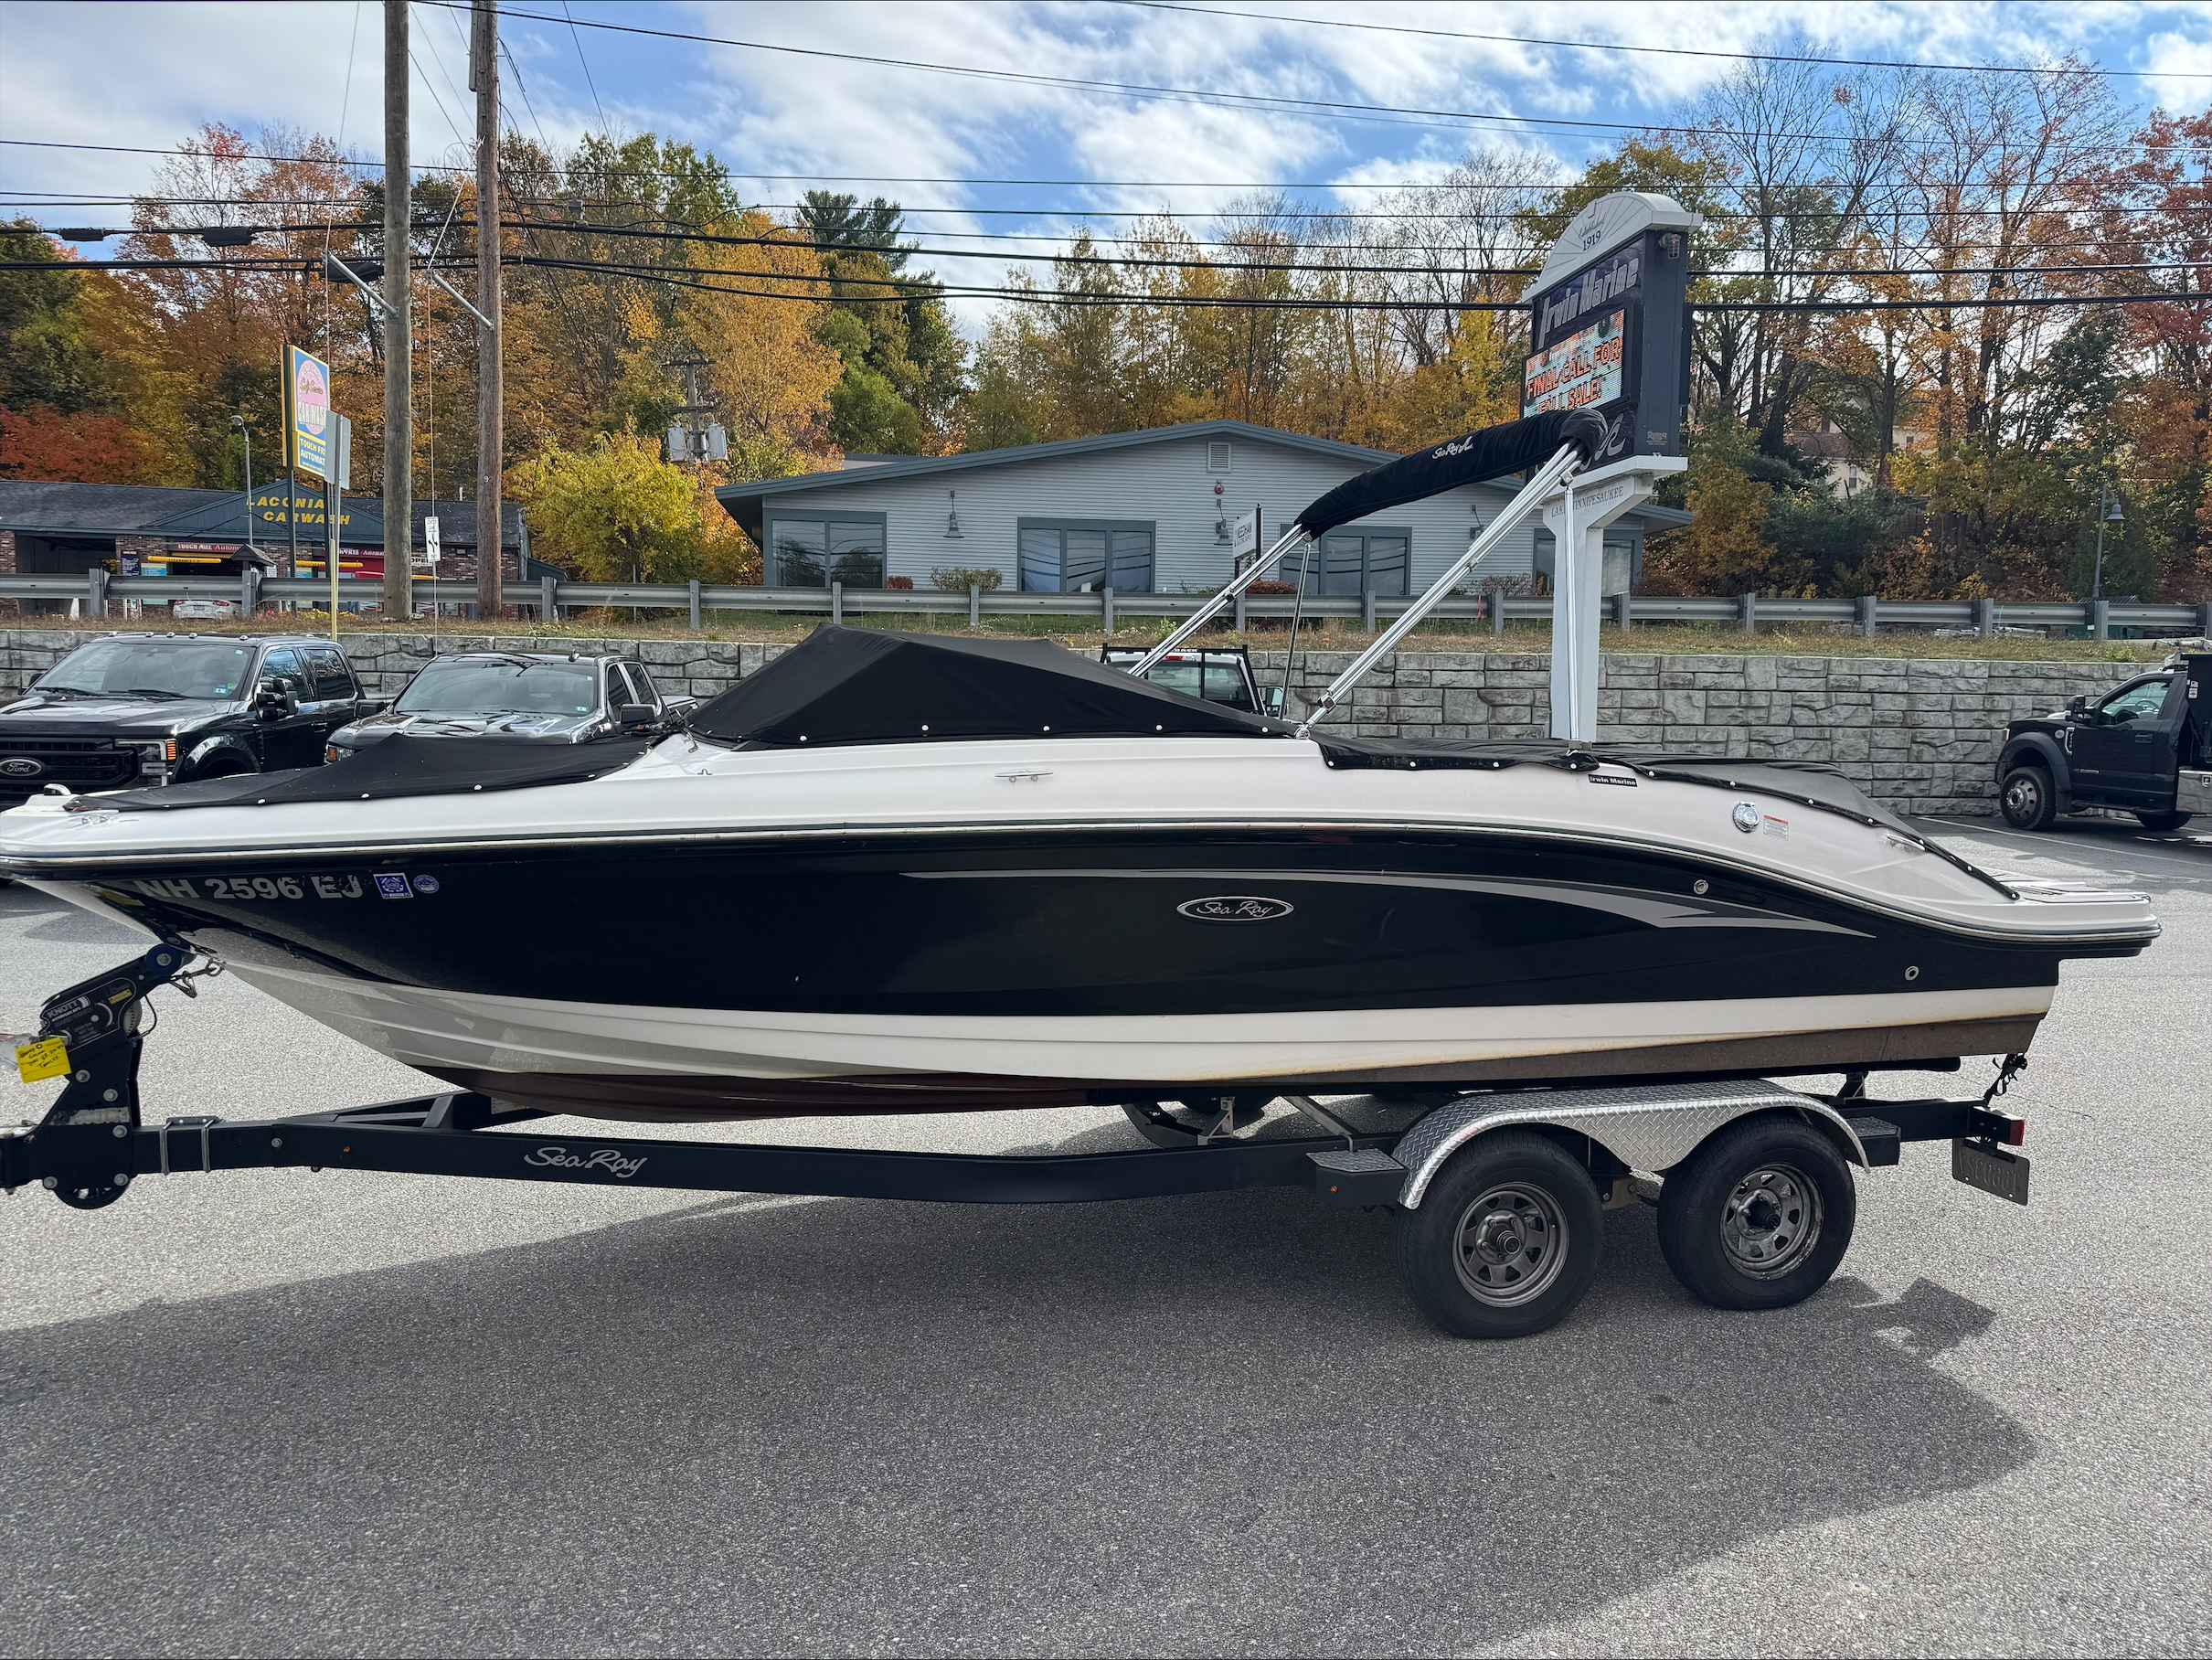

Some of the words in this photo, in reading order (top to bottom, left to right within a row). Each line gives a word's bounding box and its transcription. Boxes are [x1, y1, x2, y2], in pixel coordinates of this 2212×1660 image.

[1583, 229, 1601, 250] 1919
[1537, 287, 1579, 350] Irwin
[1579, 258, 1639, 315] Marine
[1572, 485, 1624, 511] INNIPESAUKEE
[6, 761, 31, 772] Ford
[133, 879, 200, 899] NH
[204, 877, 304, 899] 2596
[311, 875, 364, 899] EJ
[1196, 901, 1233, 915] Sea
[1235, 900, 1273, 917] Ray
[523, 1146, 587, 1168] Sea
[584, 1149, 648, 1178] Ray
